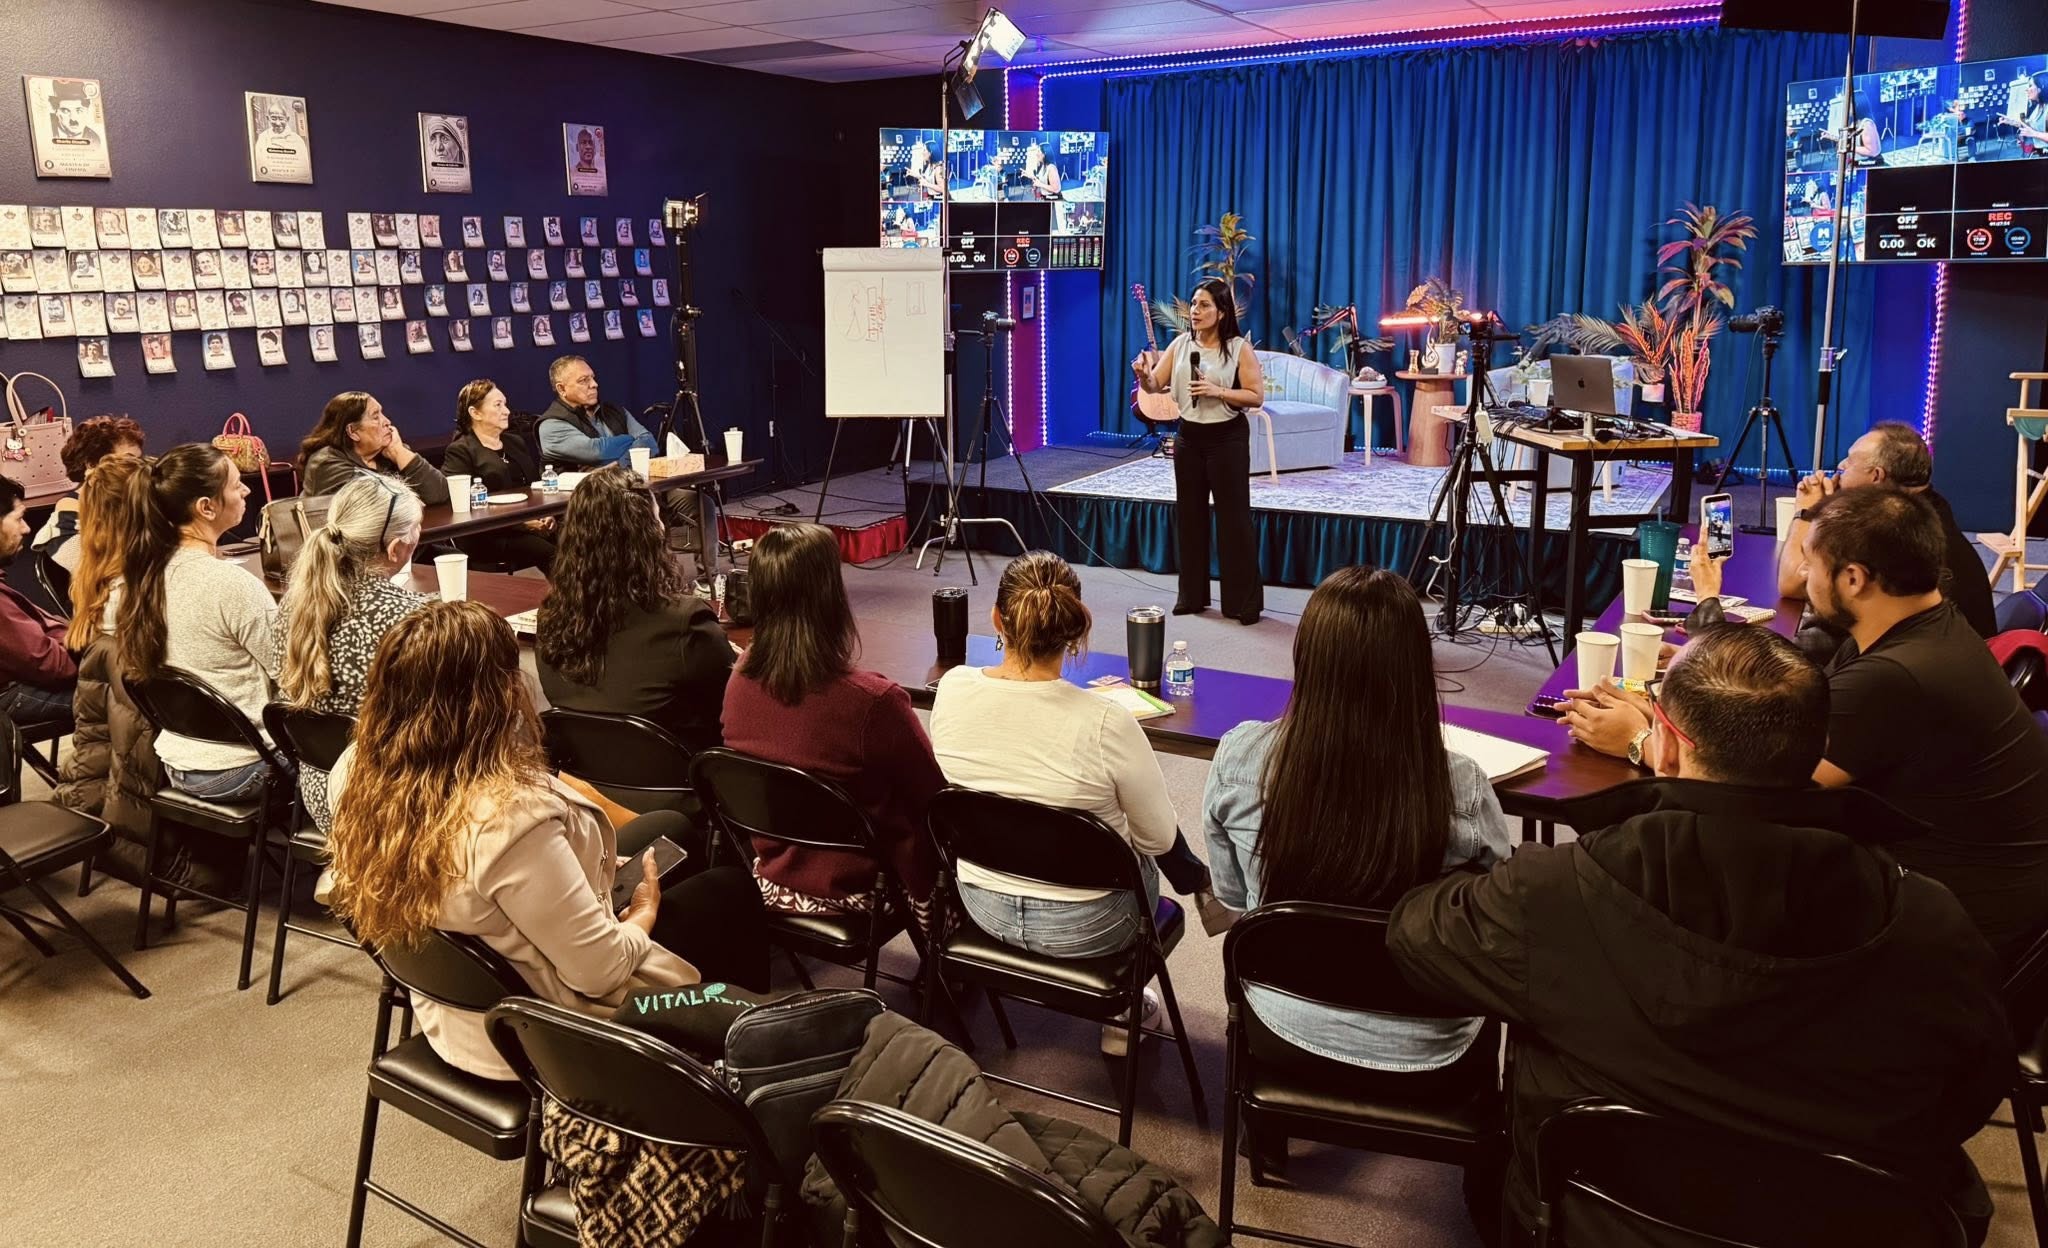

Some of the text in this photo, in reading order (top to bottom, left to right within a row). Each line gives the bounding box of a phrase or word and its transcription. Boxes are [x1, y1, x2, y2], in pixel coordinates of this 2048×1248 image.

[1897, 215, 1919, 224] OFF
[1988, 212, 2012, 221] REC
[1880, 238, 1905, 249] 0.00
[1916, 237, 1936, 248] OK
[949, 254, 967, 262] 0.00
[973, 254, 986, 262] OK
